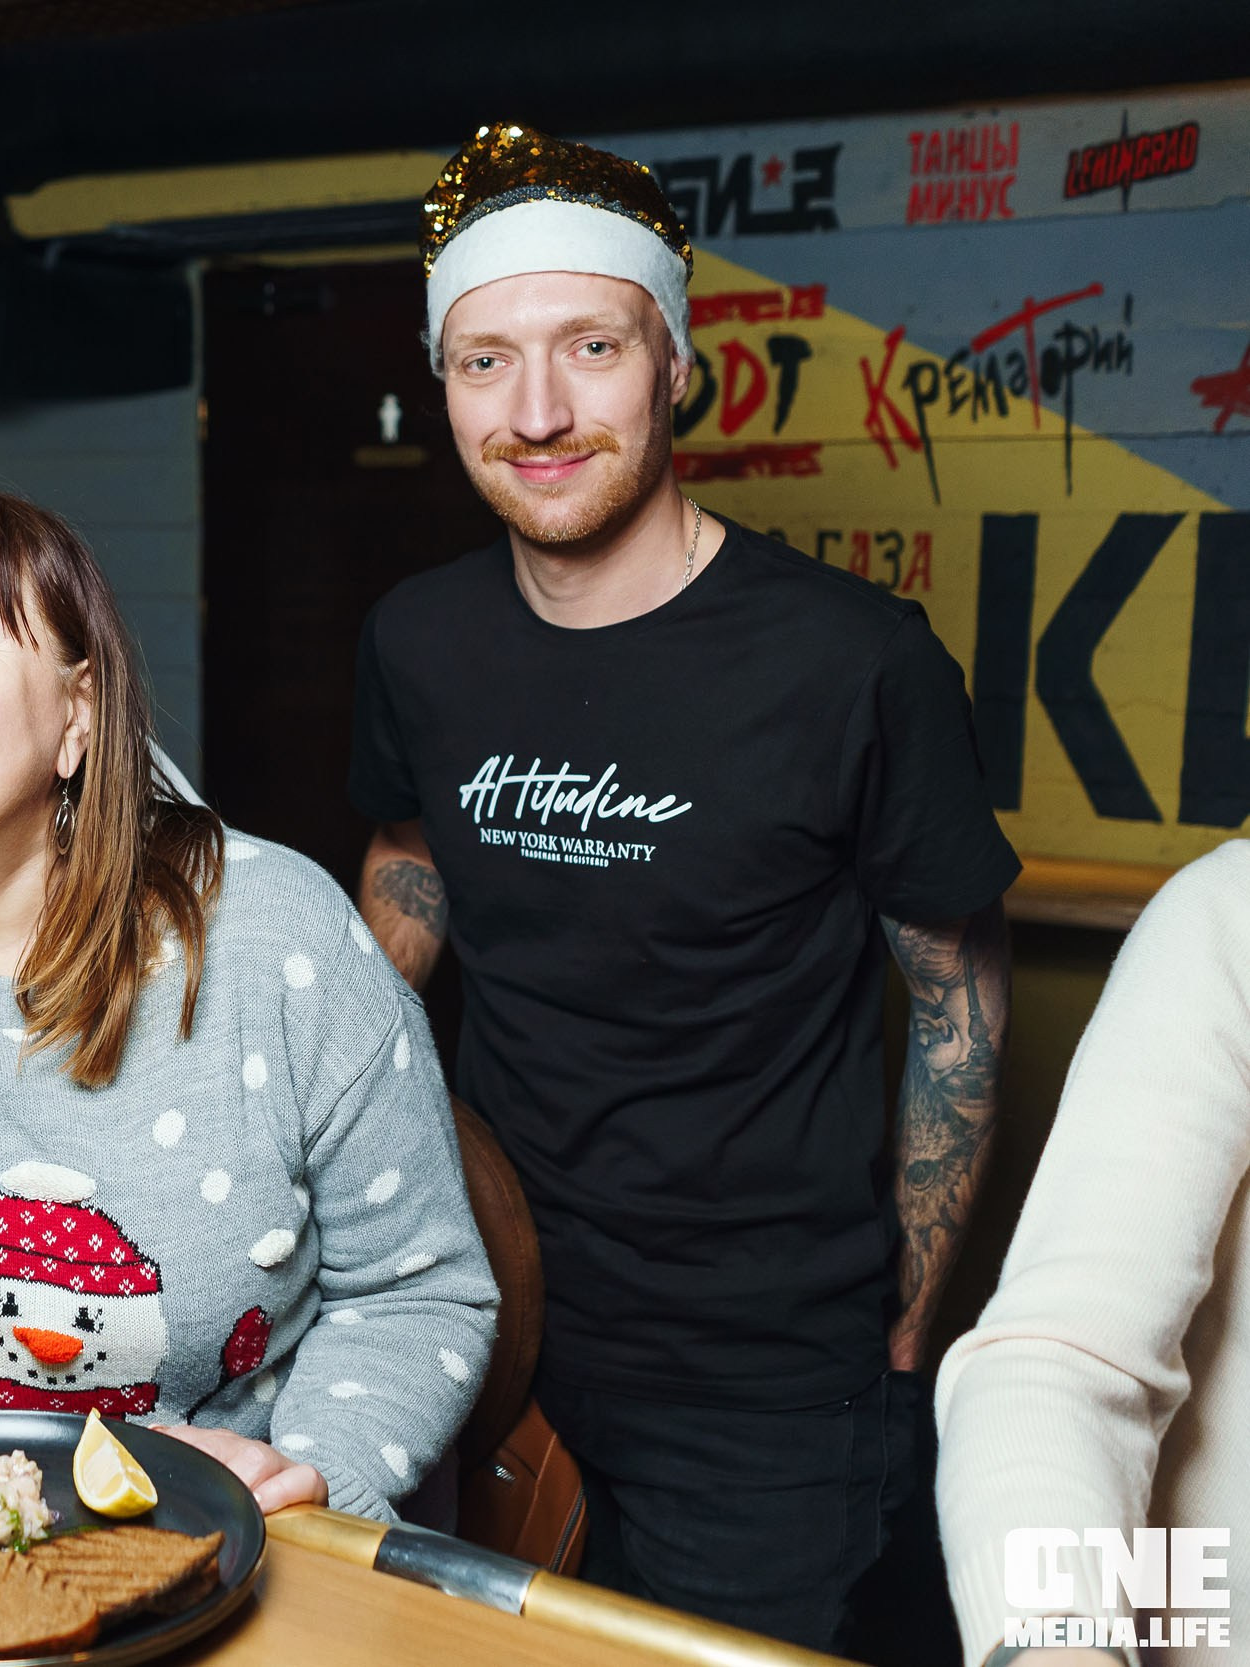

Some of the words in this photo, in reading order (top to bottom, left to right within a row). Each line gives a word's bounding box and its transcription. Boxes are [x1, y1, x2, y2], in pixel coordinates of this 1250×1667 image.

[907, 121, 1020, 175] ТАНЦЫ
[1065, 122, 1200, 199] LENINGRAD
[906, 173, 1017, 225] МИНУС
[815, 529, 933, 593] ГАЗА
[480, 827, 517, 847] NEW
[518, 831, 558, 852] YORK
[560, 836, 656, 862] WARRANTY
[520, 848, 561, 863] TRADEMARK
[564, 854, 609, 868] REGISTERED
